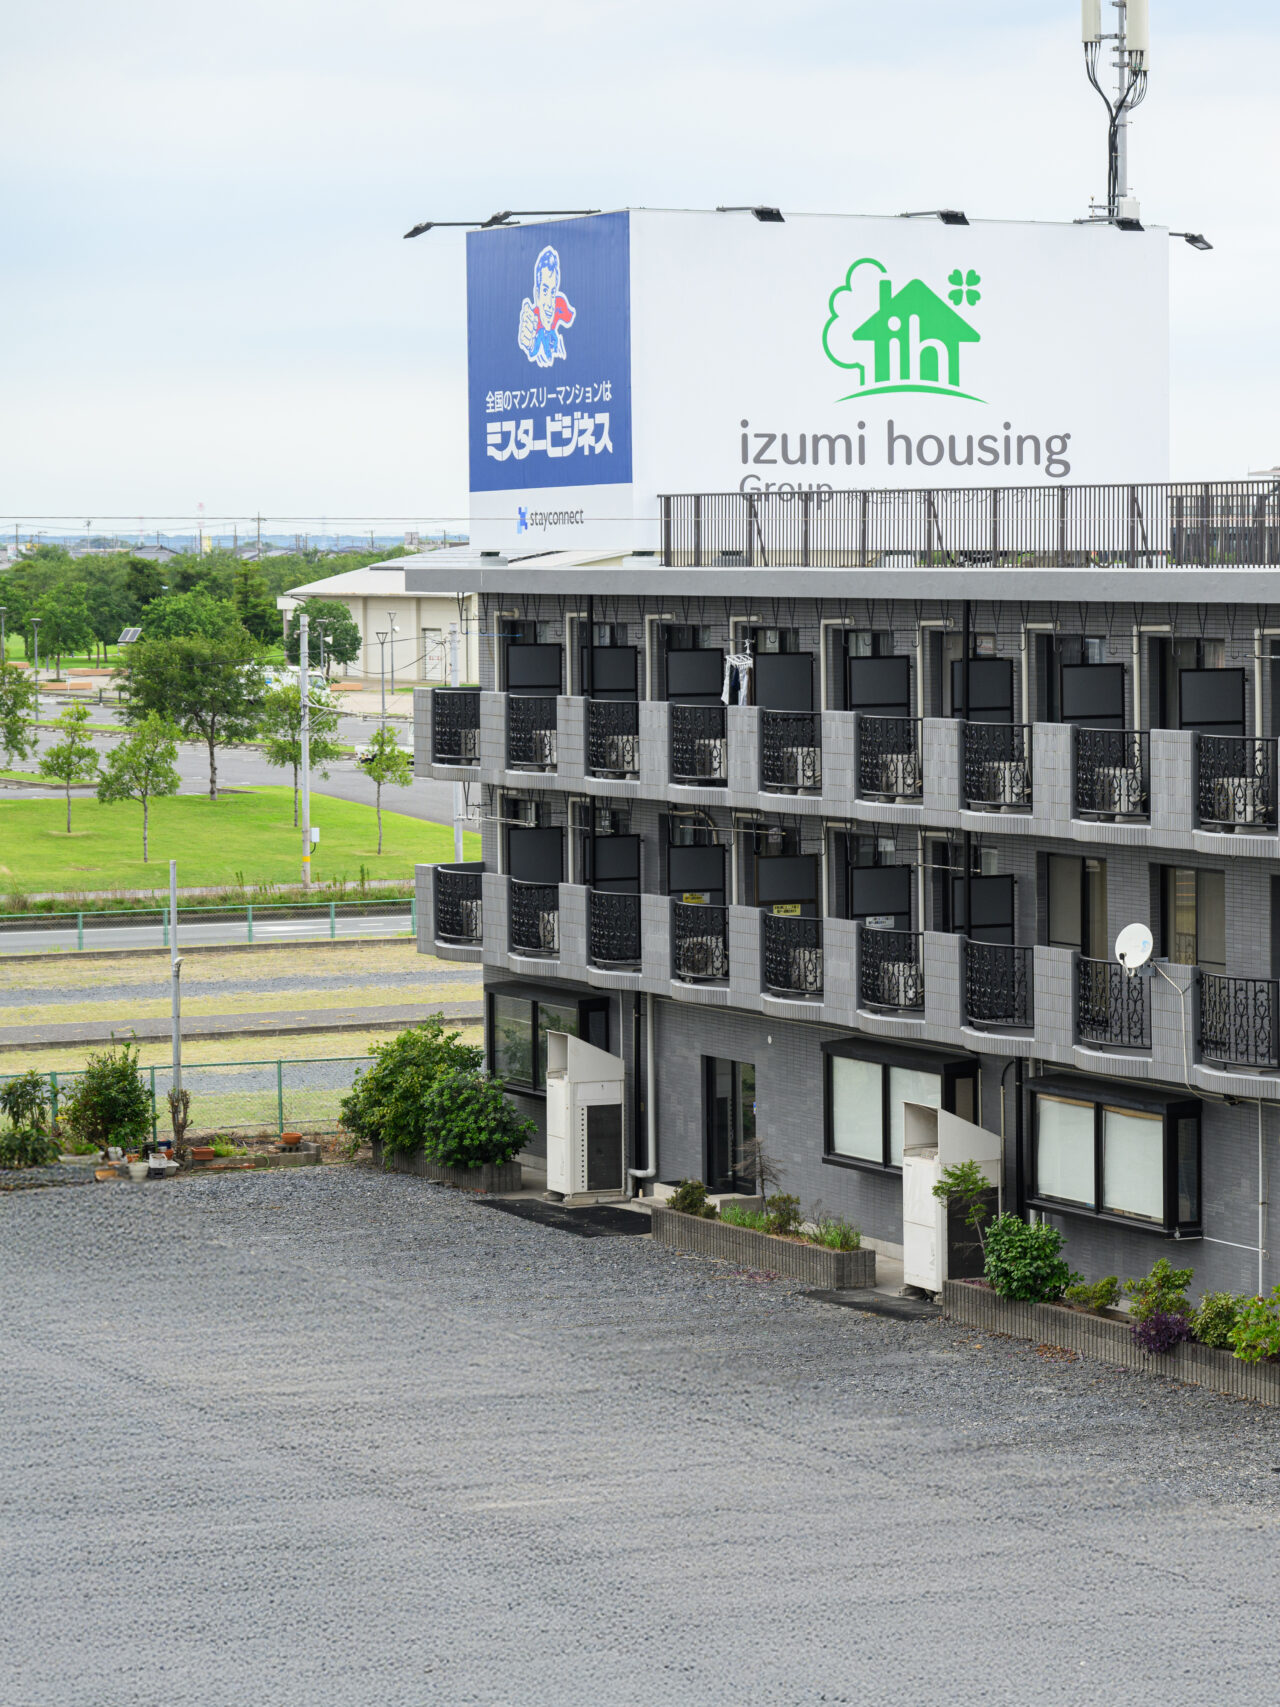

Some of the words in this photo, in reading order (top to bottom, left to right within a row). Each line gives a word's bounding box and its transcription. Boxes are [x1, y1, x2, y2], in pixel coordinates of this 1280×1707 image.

[486, 380, 612, 413] 全国のマンスリーマンションは
[487, 412, 613, 461] ミスタービジネス
[740, 419, 866, 465] izumi
[887, 419, 1072, 478] housing
[739, 474, 834, 510] Group
[530, 508, 584, 531] stayconnect
